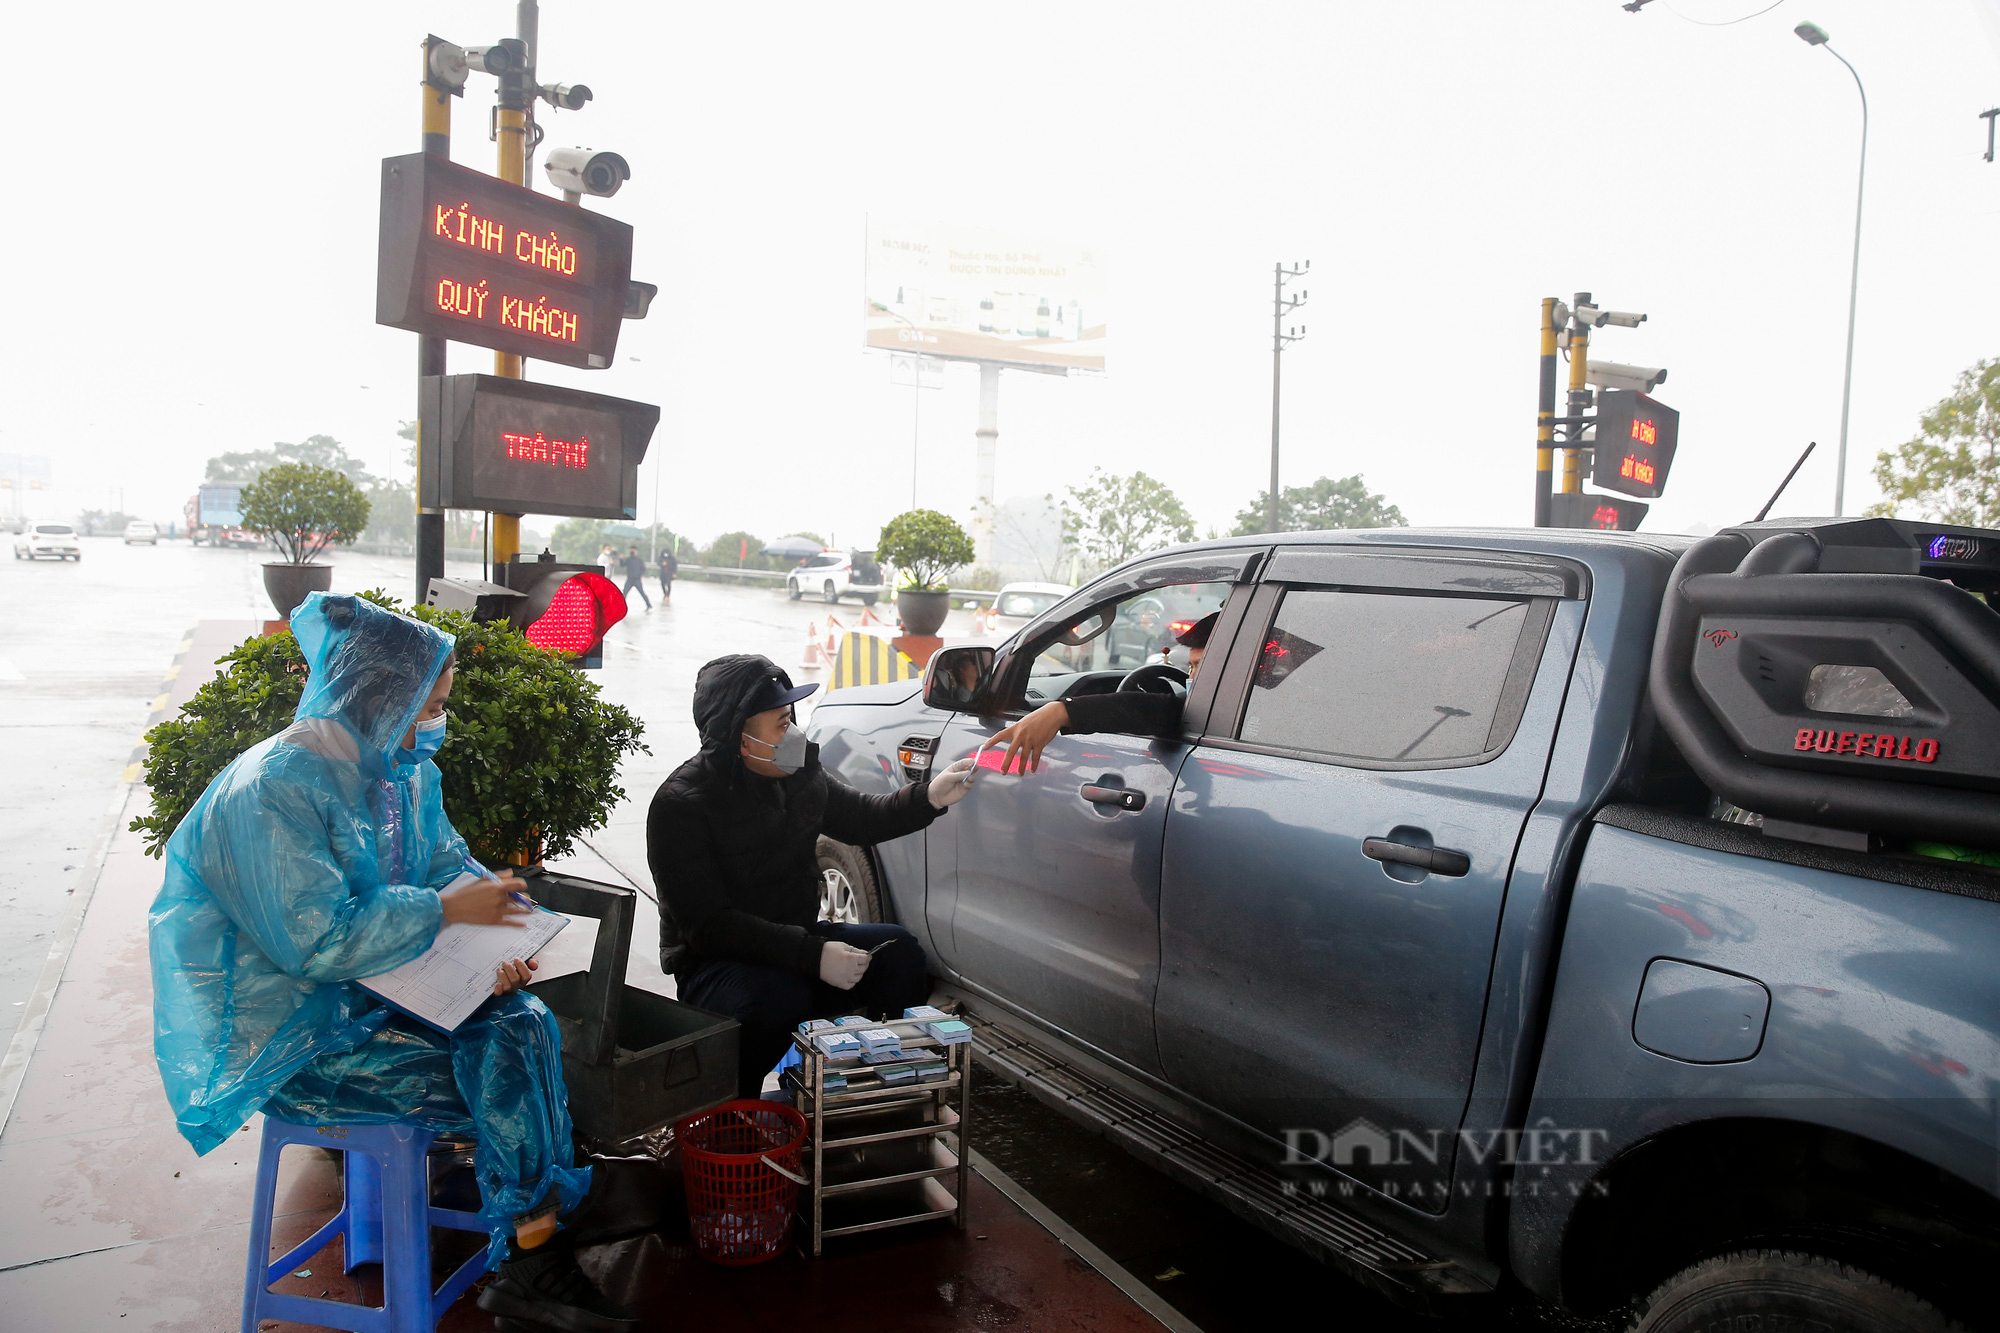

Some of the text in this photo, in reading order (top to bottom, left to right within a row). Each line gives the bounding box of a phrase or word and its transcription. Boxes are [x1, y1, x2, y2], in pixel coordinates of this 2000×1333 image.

[435, 202, 577, 276] KÍNH CHÀO
[437, 279, 578, 342] QUÝ KHÁCH
[551, 435, 589, 470] PHÍ
[1794, 728, 1941, 763] BUFFALO
